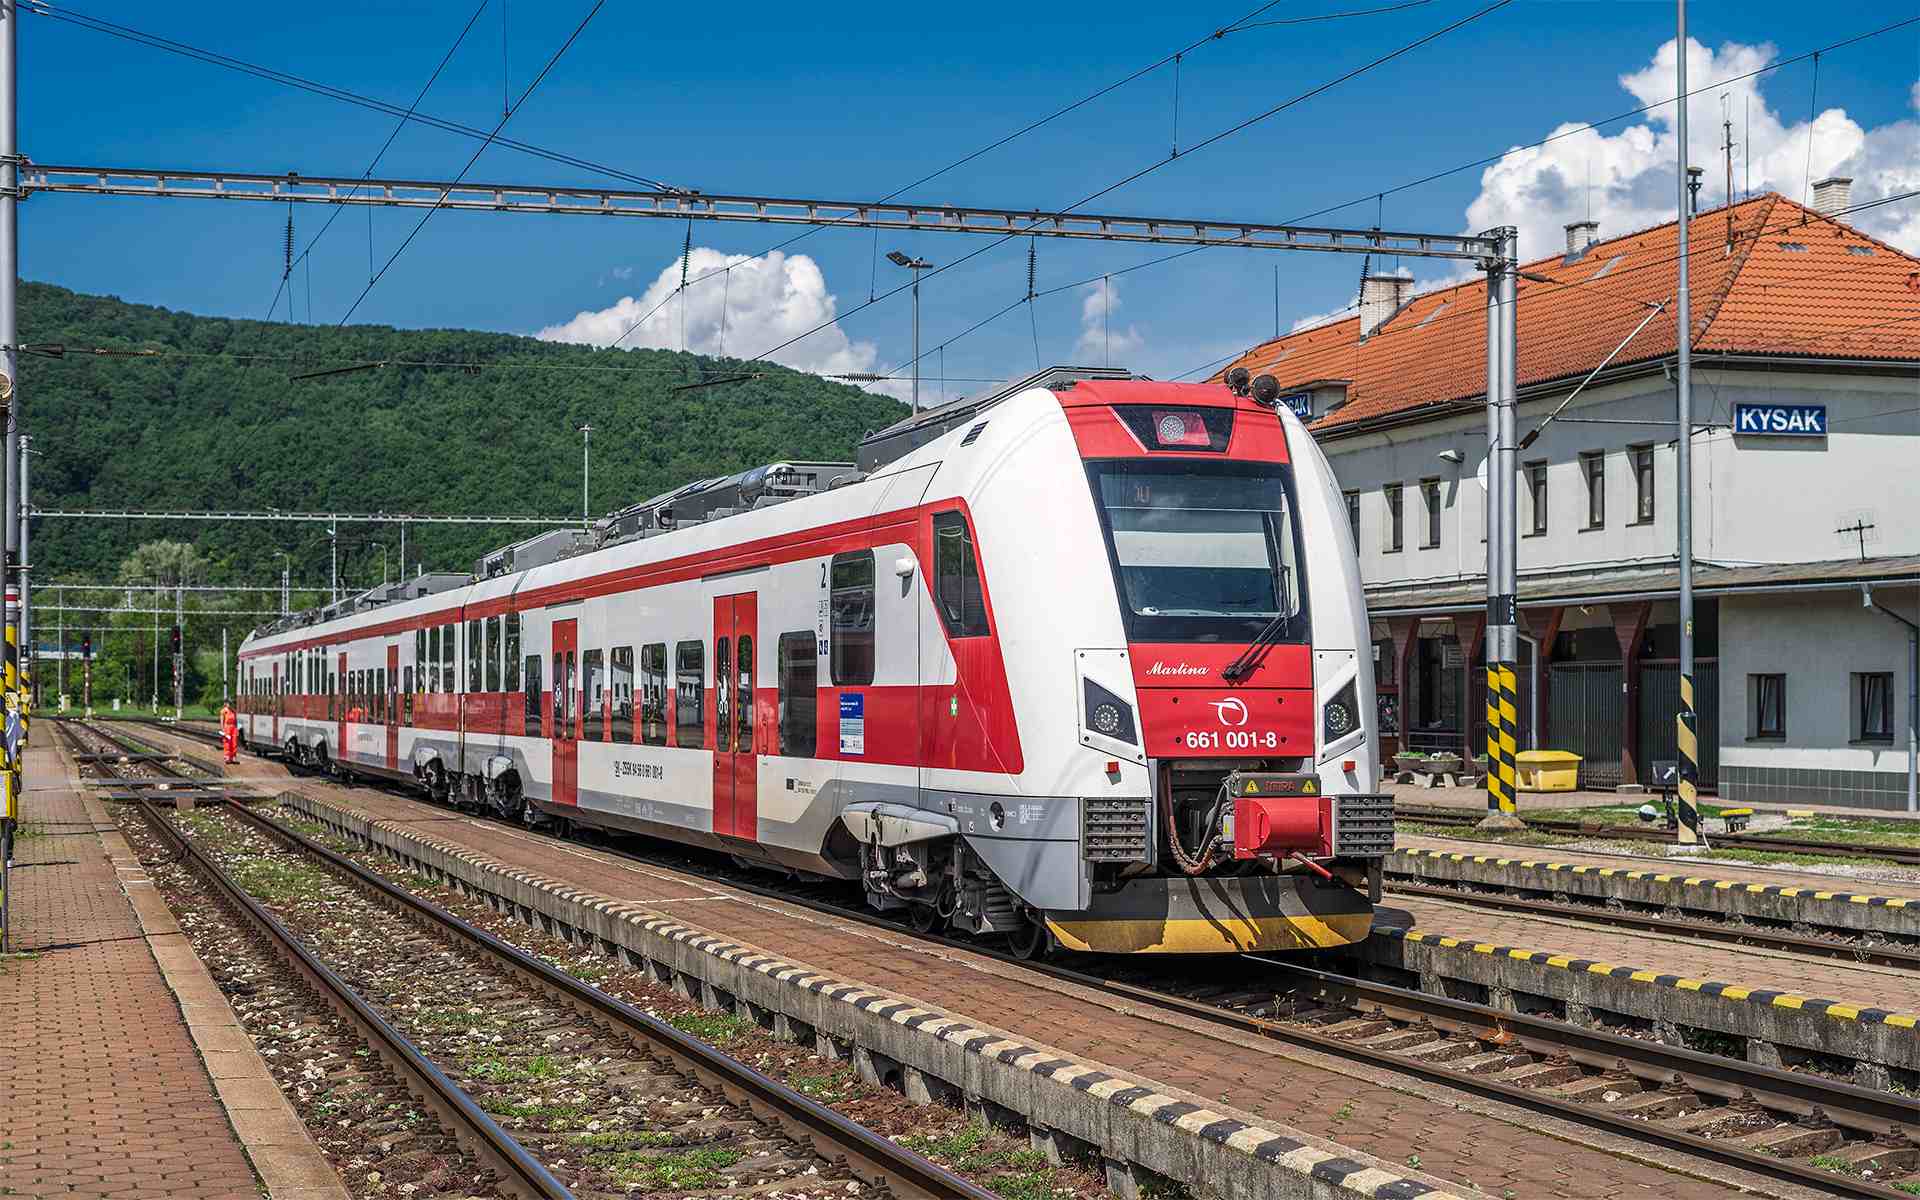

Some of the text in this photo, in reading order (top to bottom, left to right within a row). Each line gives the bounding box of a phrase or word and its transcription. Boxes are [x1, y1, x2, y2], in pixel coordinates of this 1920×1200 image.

[1285, 396, 1307, 415] SAK
[1741, 408, 1821, 431] KYSAK
[821, 562, 827, 589] 2
[1146, 661, 1209, 676] Martina
[1186, 731, 1278, 748] 661 001-8
